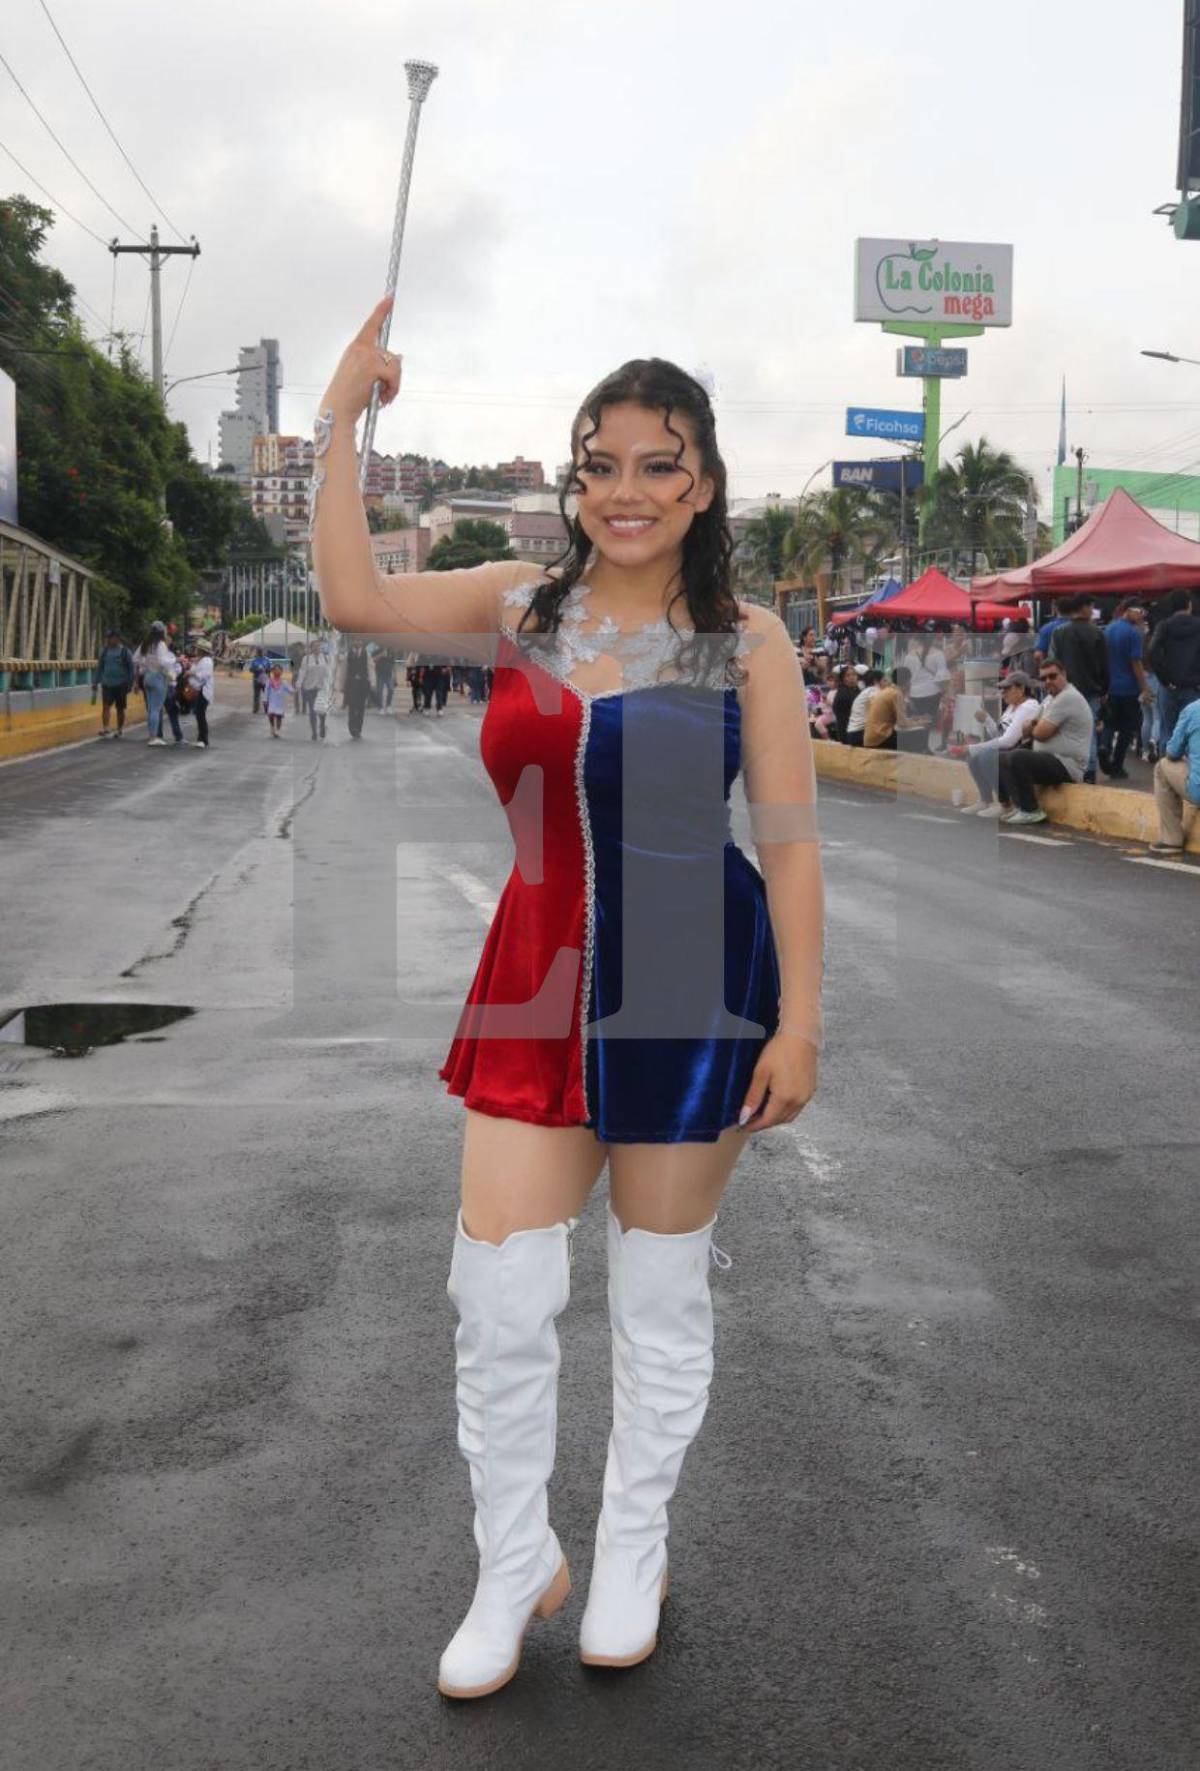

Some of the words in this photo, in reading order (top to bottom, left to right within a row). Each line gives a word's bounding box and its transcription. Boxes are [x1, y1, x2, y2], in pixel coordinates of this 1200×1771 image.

[885, 259, 913, 291] La
[918, 260, 995, 293] Colonia
[943, 293, 995, 321] mega
[866, 418, 919, 435] Ficohsa
